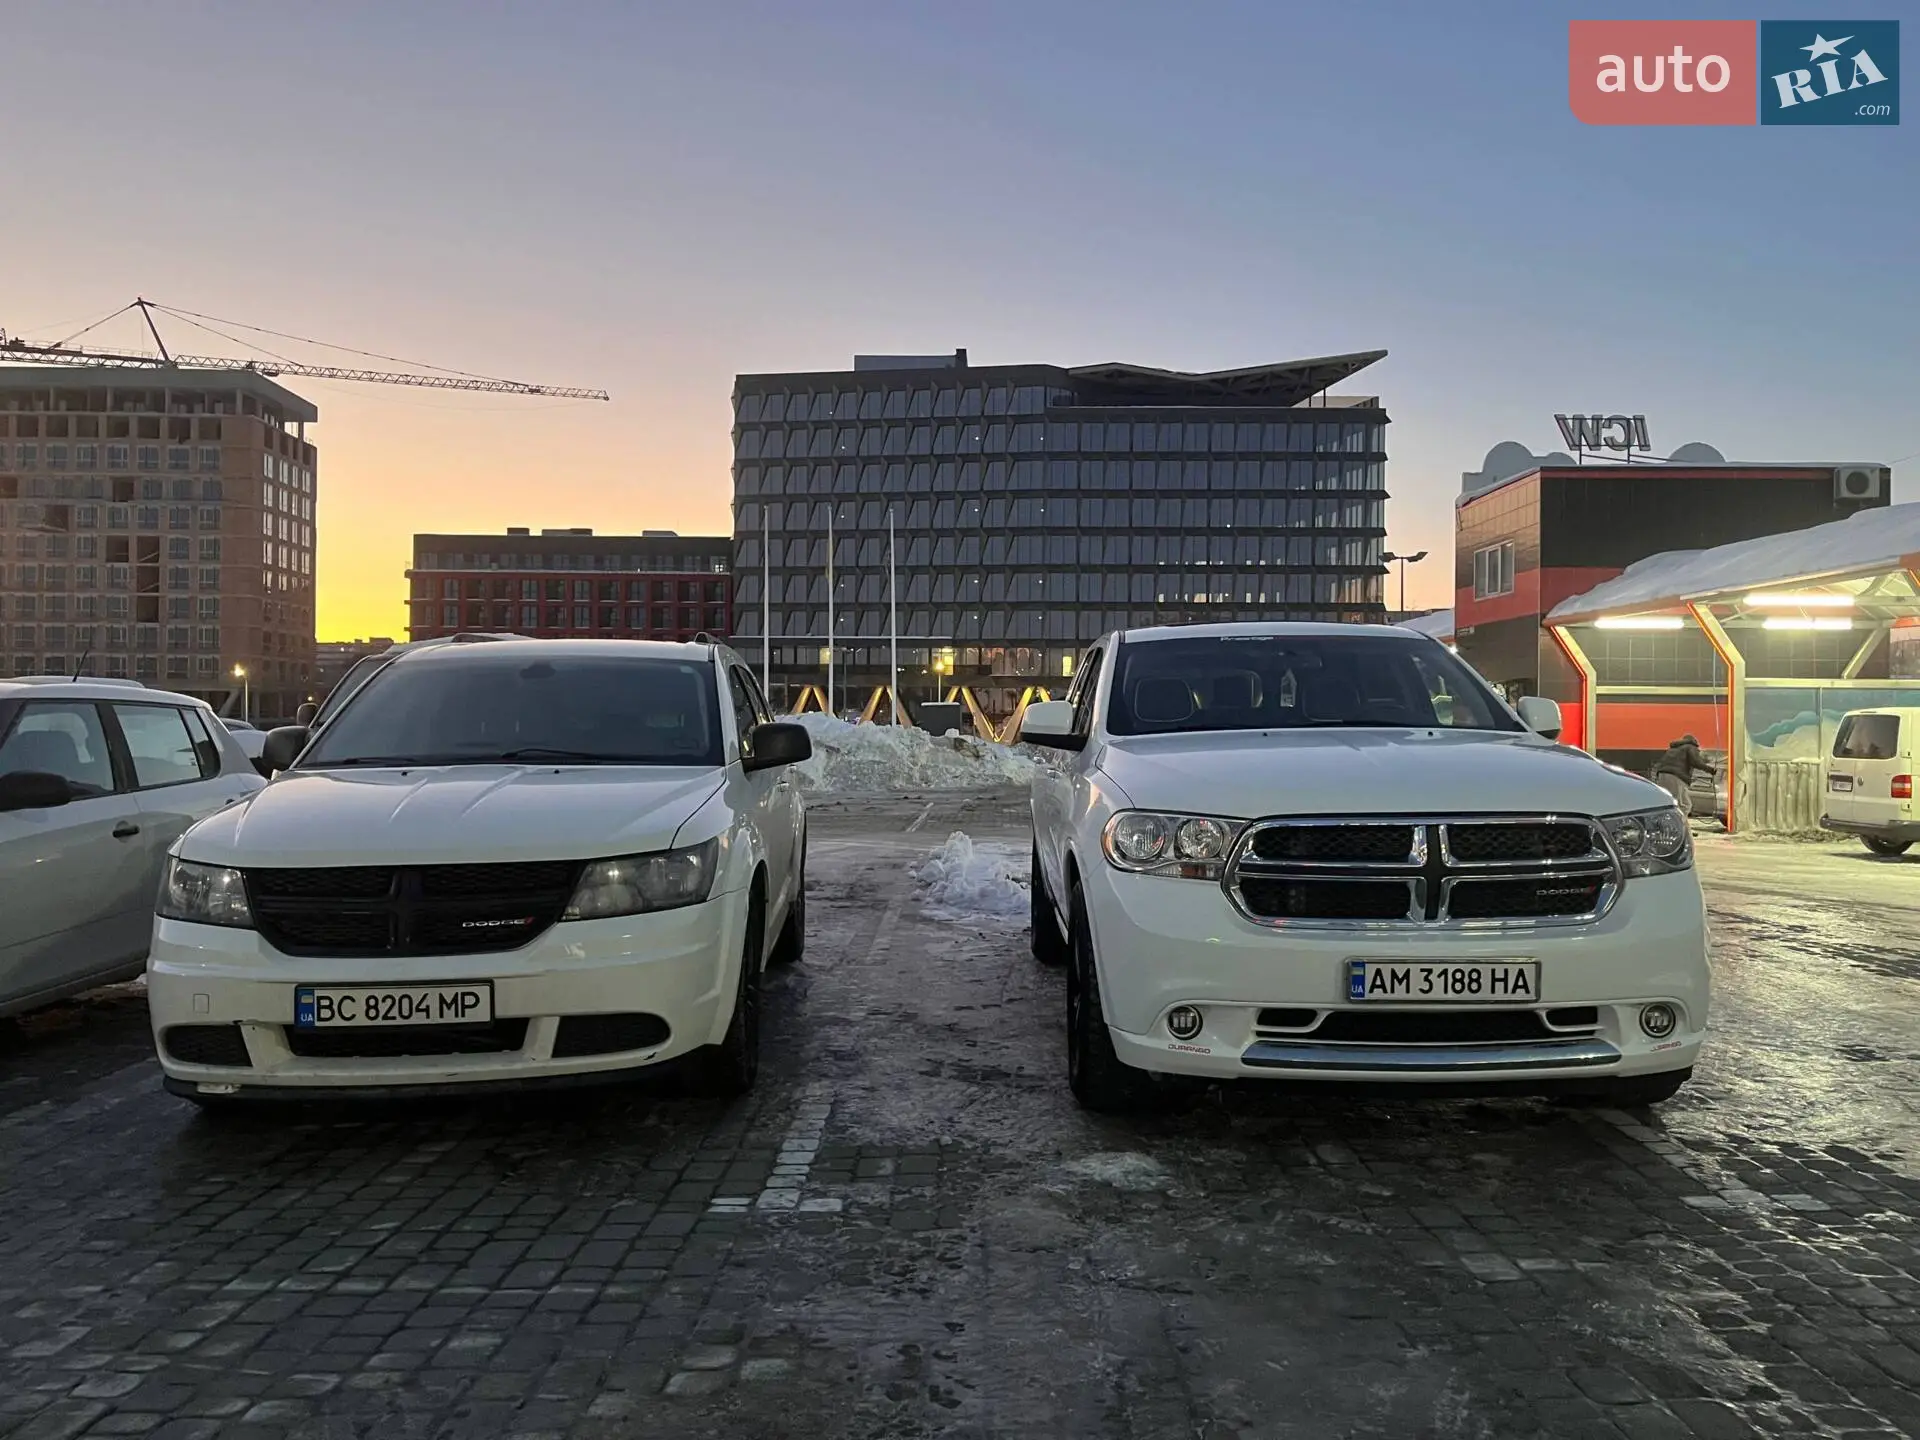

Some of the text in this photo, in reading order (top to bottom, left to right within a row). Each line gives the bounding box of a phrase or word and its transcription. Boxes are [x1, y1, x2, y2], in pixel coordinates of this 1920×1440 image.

[462, 918, 525, 928] DODGE
[1368, 968, 1531, 994] AM 3188 HA
[1351, 984, 1364, 994] UA
[316, 991, 480, 1022] BC 8204 MP
[301, 1013, 313, 1022] UA
